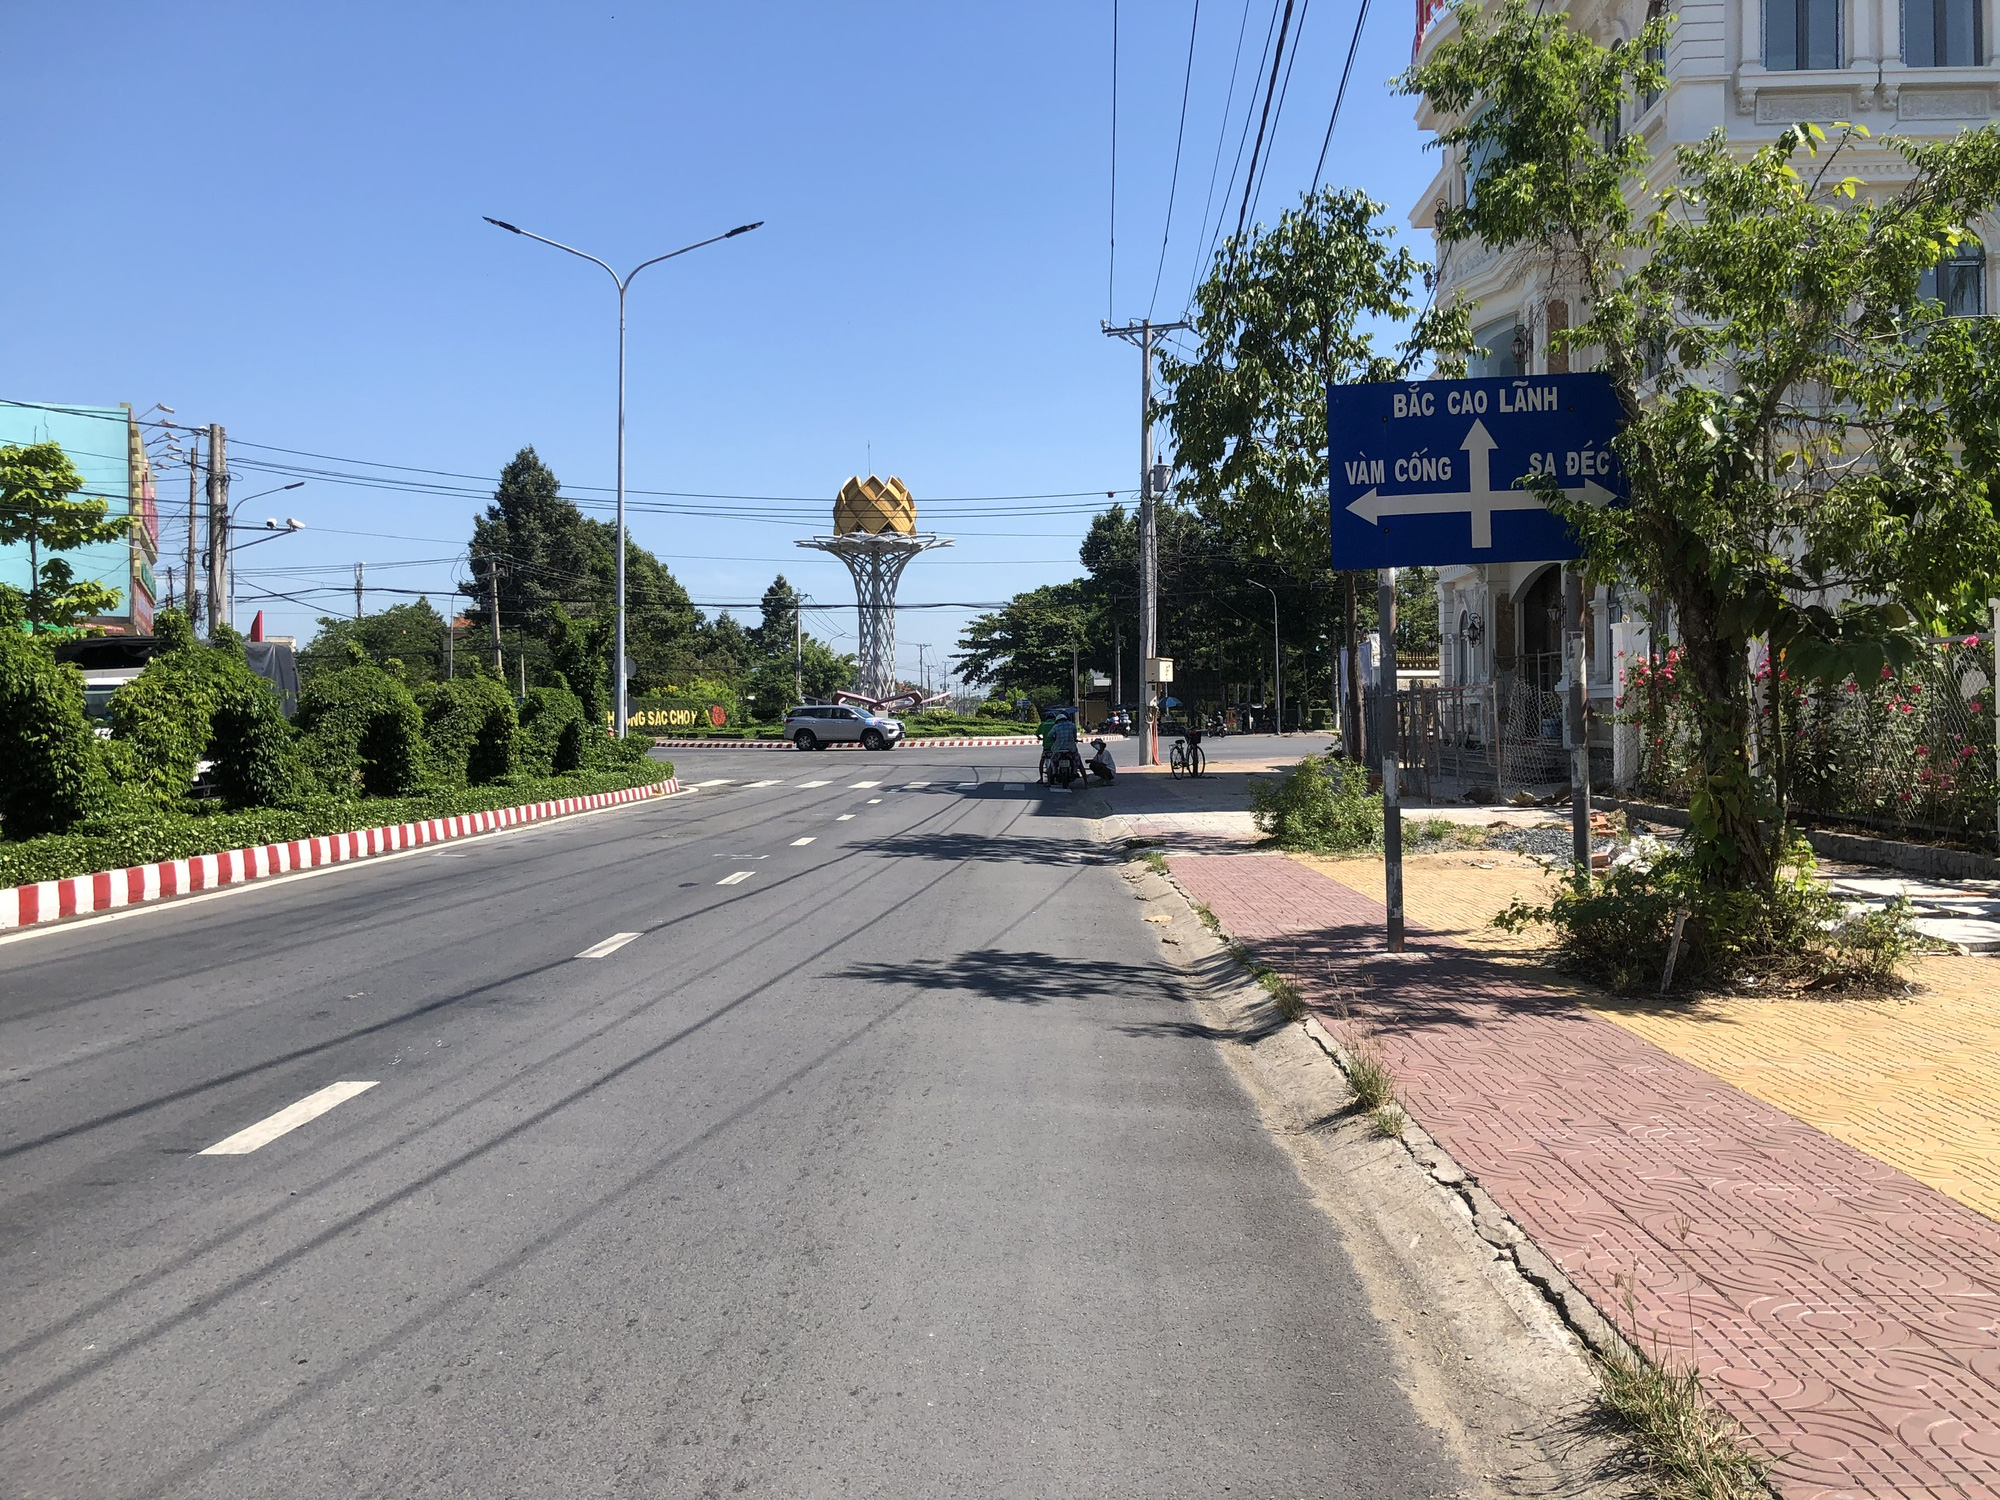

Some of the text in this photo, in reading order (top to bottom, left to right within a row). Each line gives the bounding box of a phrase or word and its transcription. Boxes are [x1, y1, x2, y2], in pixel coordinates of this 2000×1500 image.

[1393, 380, 1558, 418] BẮC CAO LÃNH
[1344, 447, 1452, 485] VÀM CỐNG
[1529, 440, 1610, 477] SA ĐÉC
